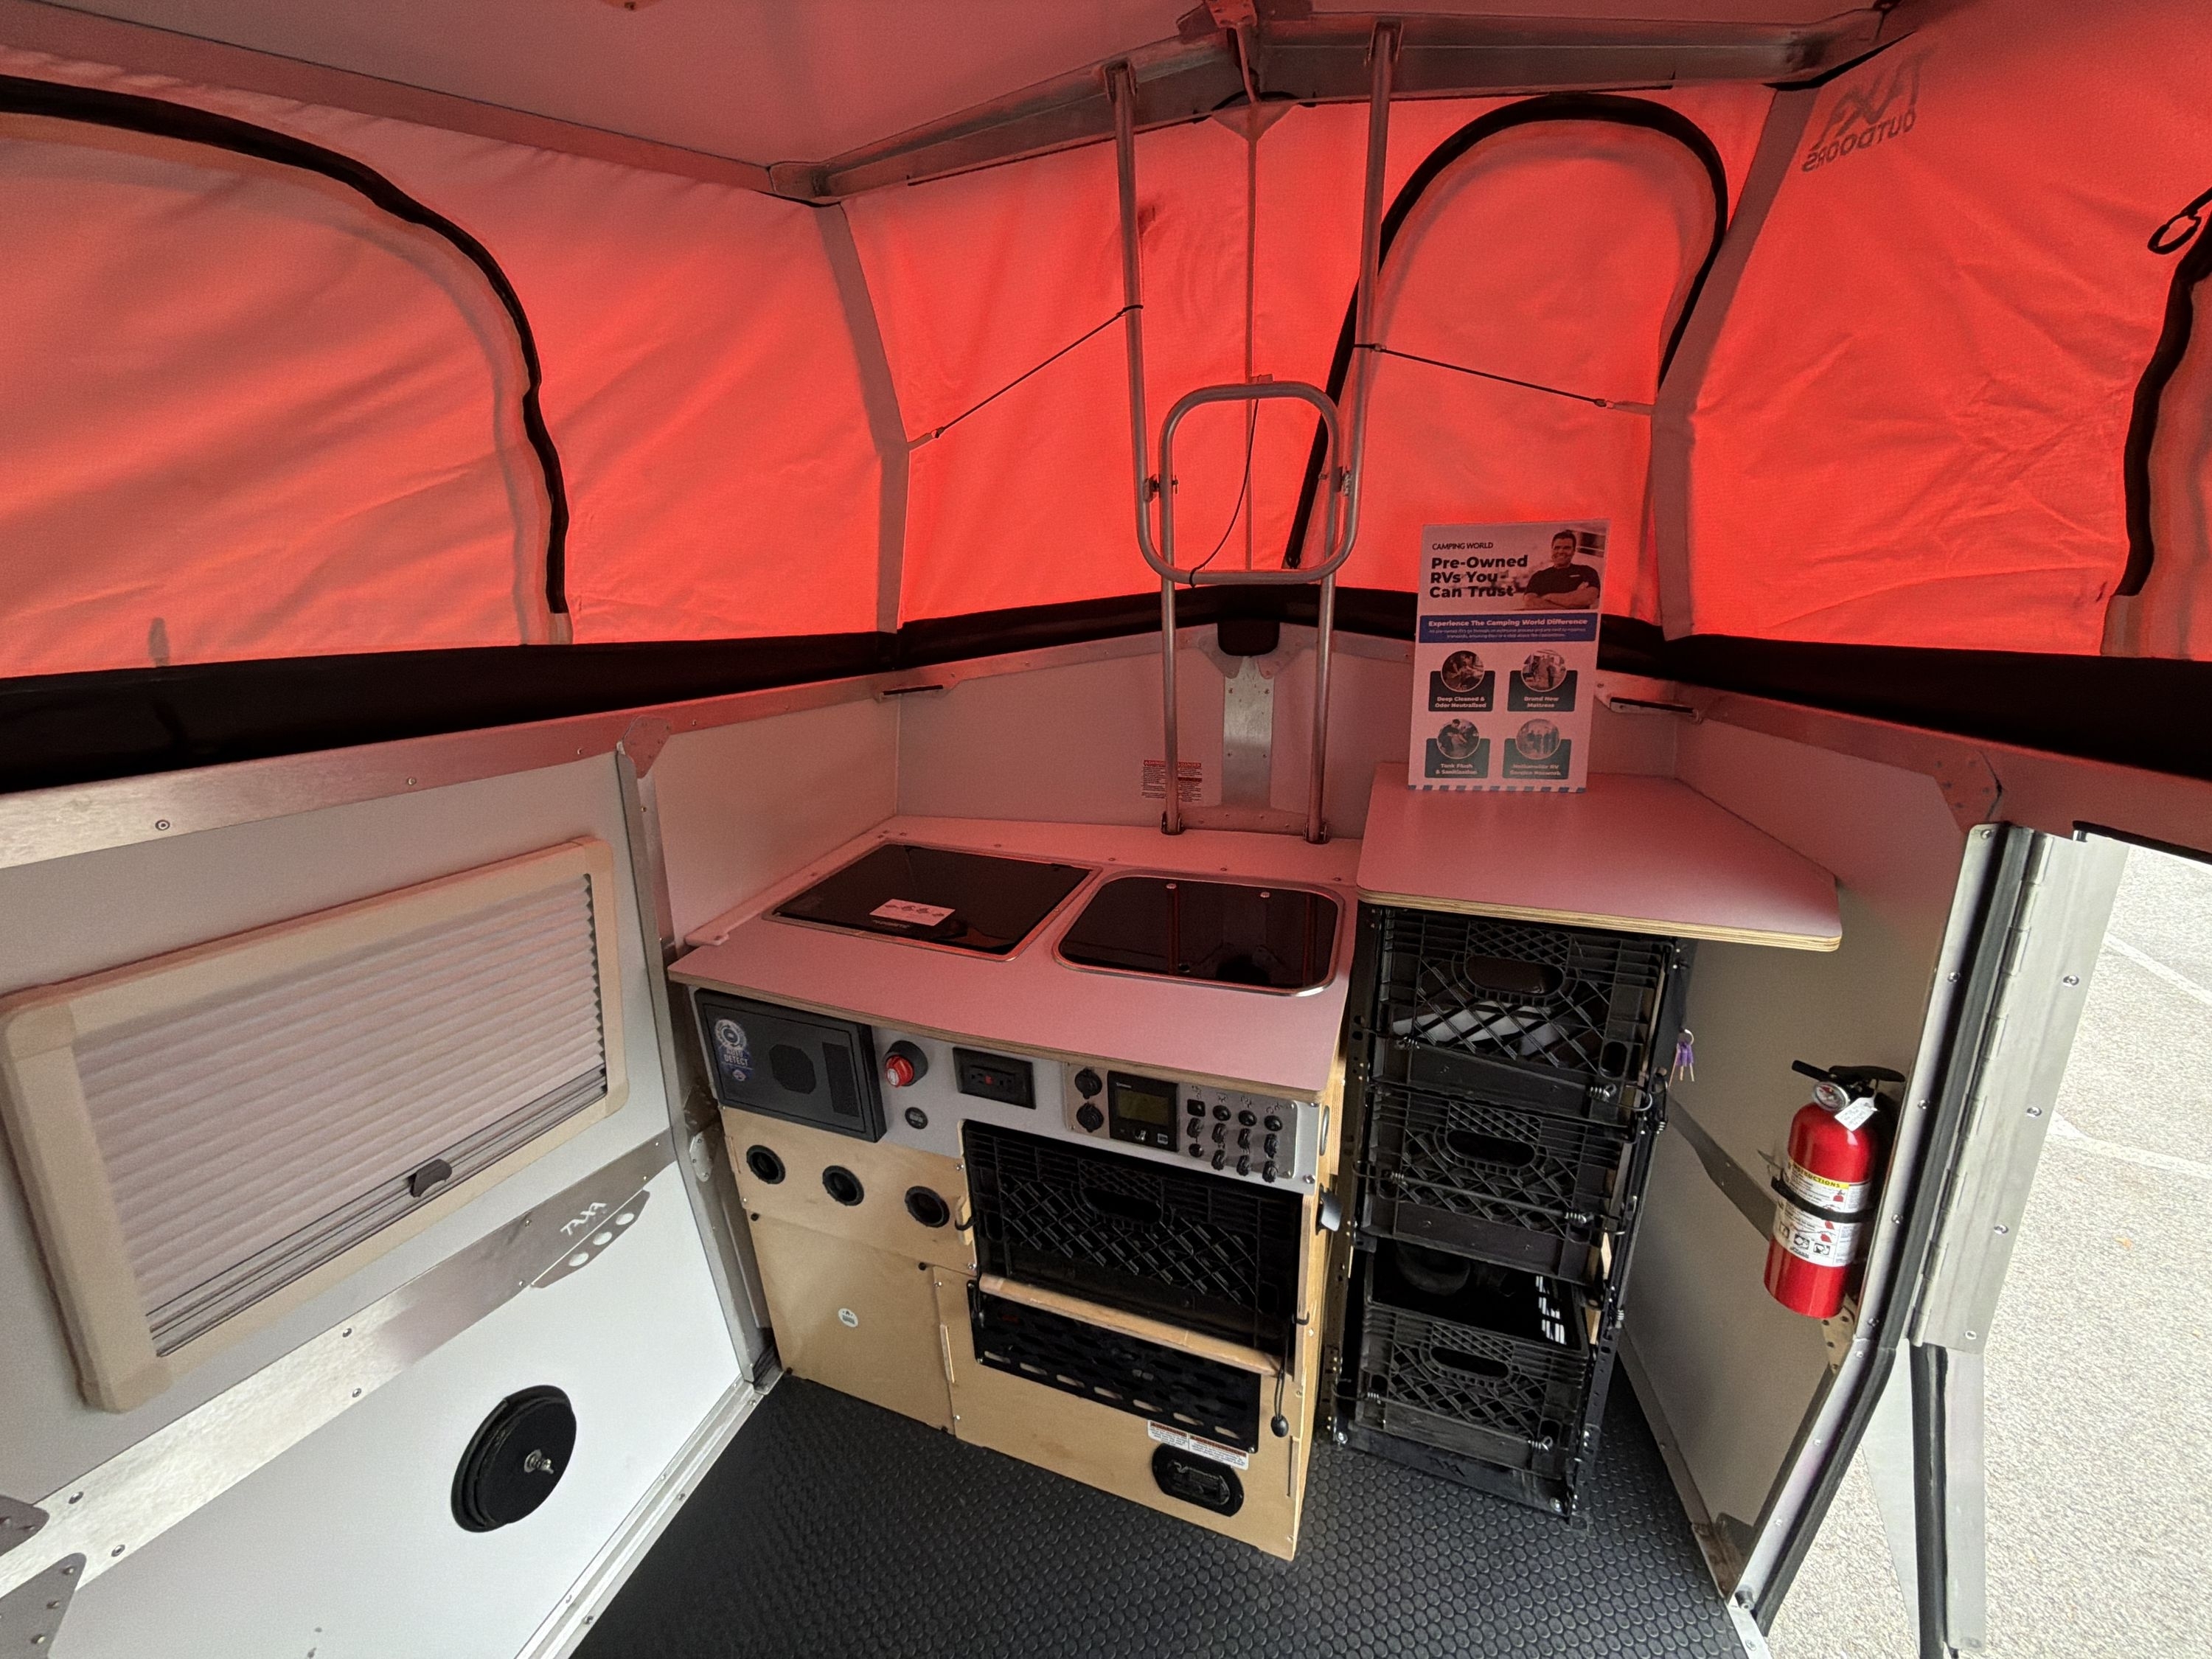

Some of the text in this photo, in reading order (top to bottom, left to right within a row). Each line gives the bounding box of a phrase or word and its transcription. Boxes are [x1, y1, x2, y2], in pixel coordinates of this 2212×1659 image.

[1431, 554, 1528, 568] Pre-Owned
[1430, 571, 1498, 583] RVs You
[1430, 585, 1514, 598] Can Trust
[723, 1054, 748, 1067] DETECT
